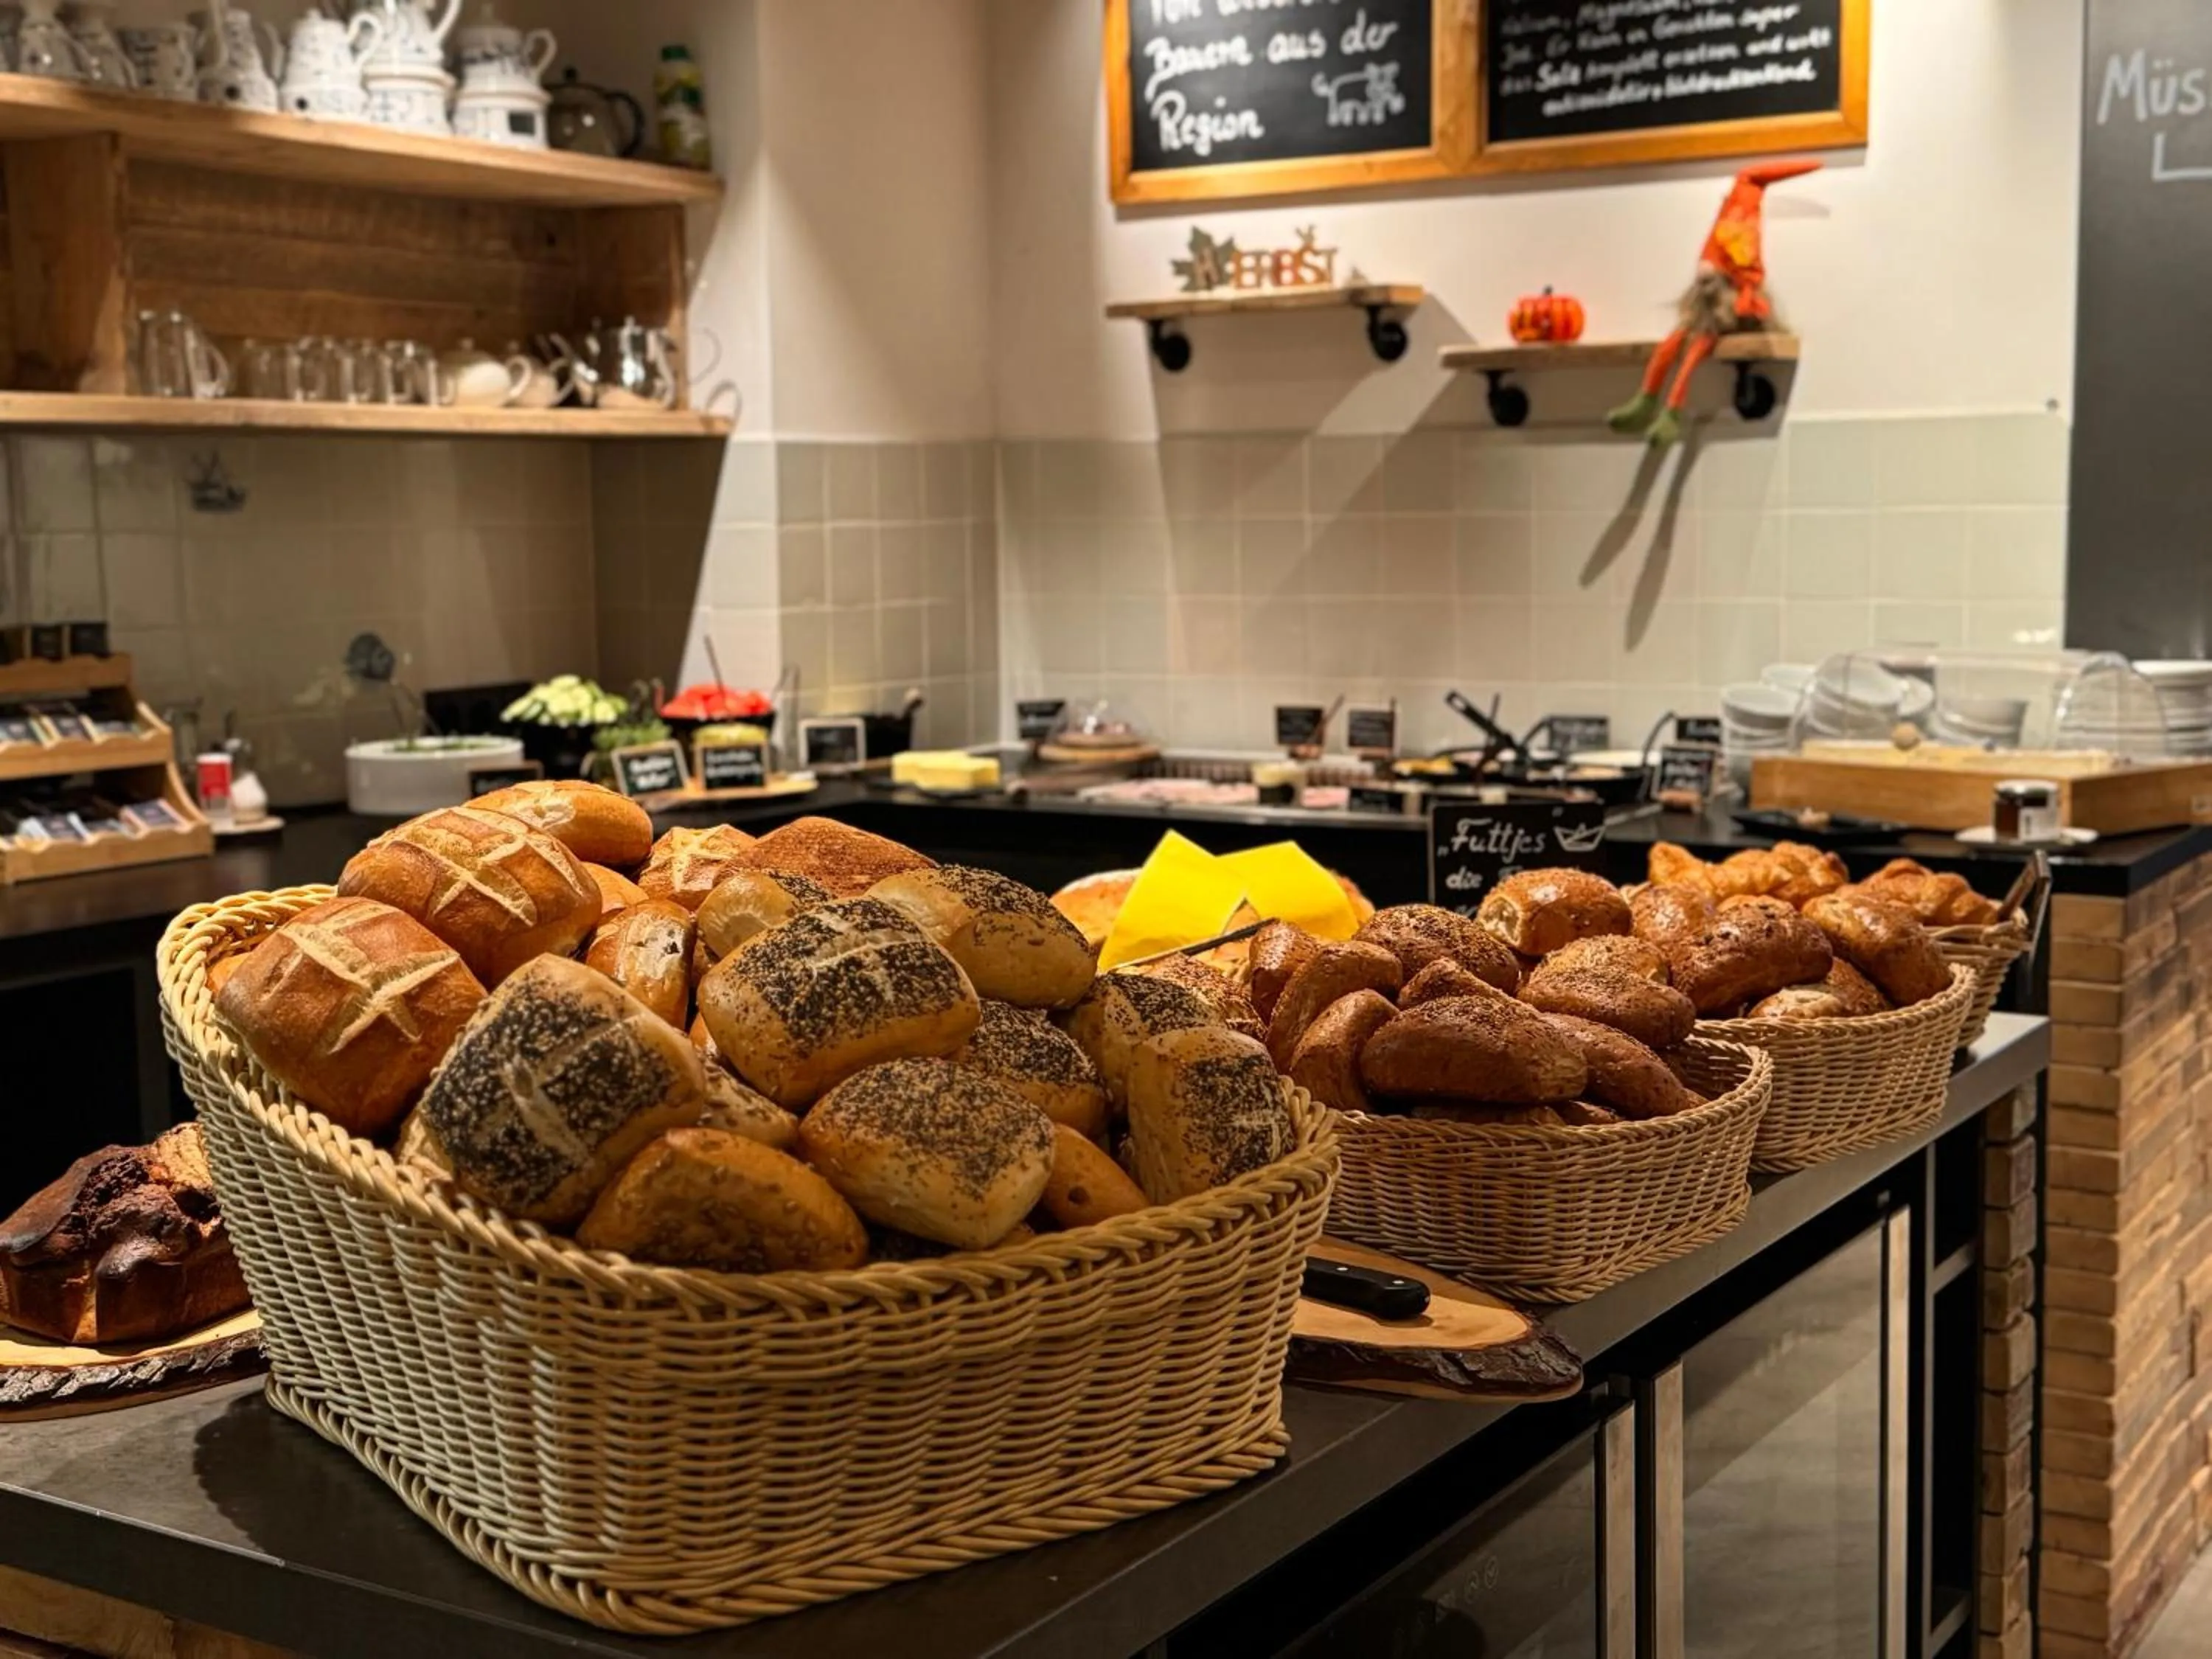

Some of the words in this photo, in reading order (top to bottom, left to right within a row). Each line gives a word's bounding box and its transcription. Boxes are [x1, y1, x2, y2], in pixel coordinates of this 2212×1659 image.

[1267, 29, 1326, 63] aus
[1340, 9, 1397, 55] der
[1152, 90, 1265, 156] Region
